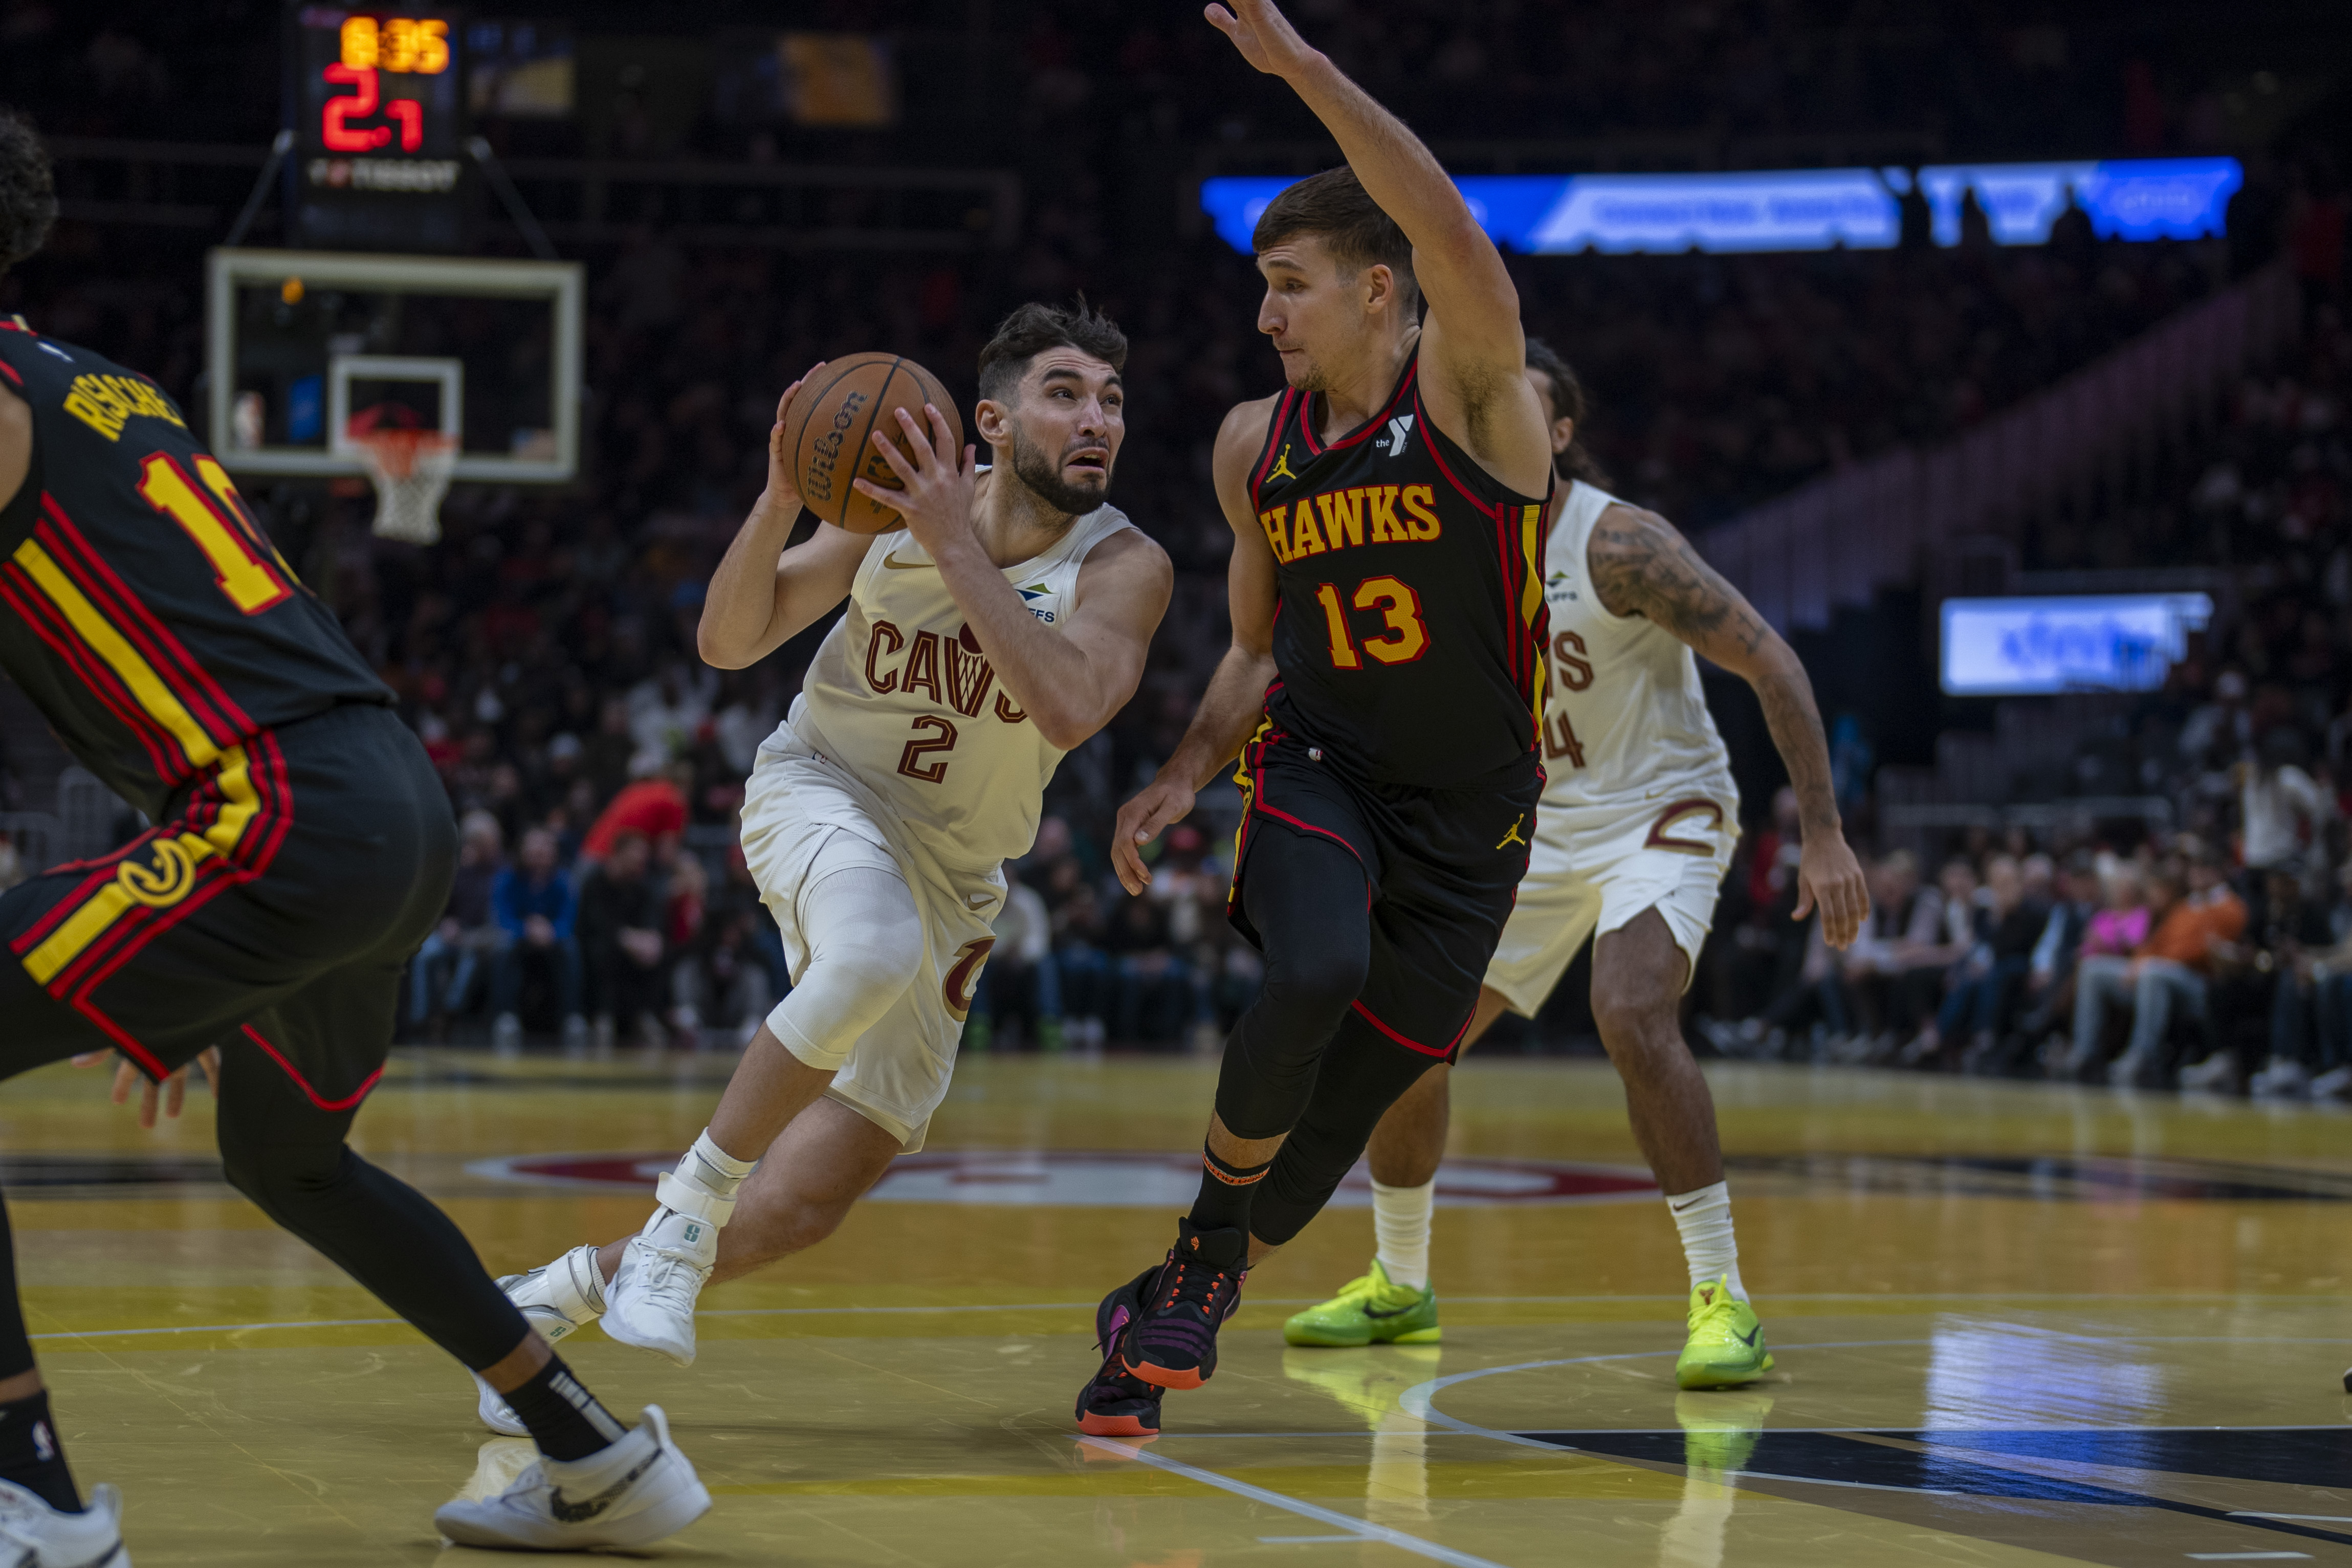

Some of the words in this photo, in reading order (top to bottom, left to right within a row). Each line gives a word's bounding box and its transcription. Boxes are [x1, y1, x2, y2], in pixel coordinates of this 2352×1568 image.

[806, 390, 869, 502] Wilson
[1376, 439, 1390, 448] the
[1259, 483, 1443, 566] HAWKS
[1314, 574, 1432, 671] 13
[896, 714, 958, 784] 2
